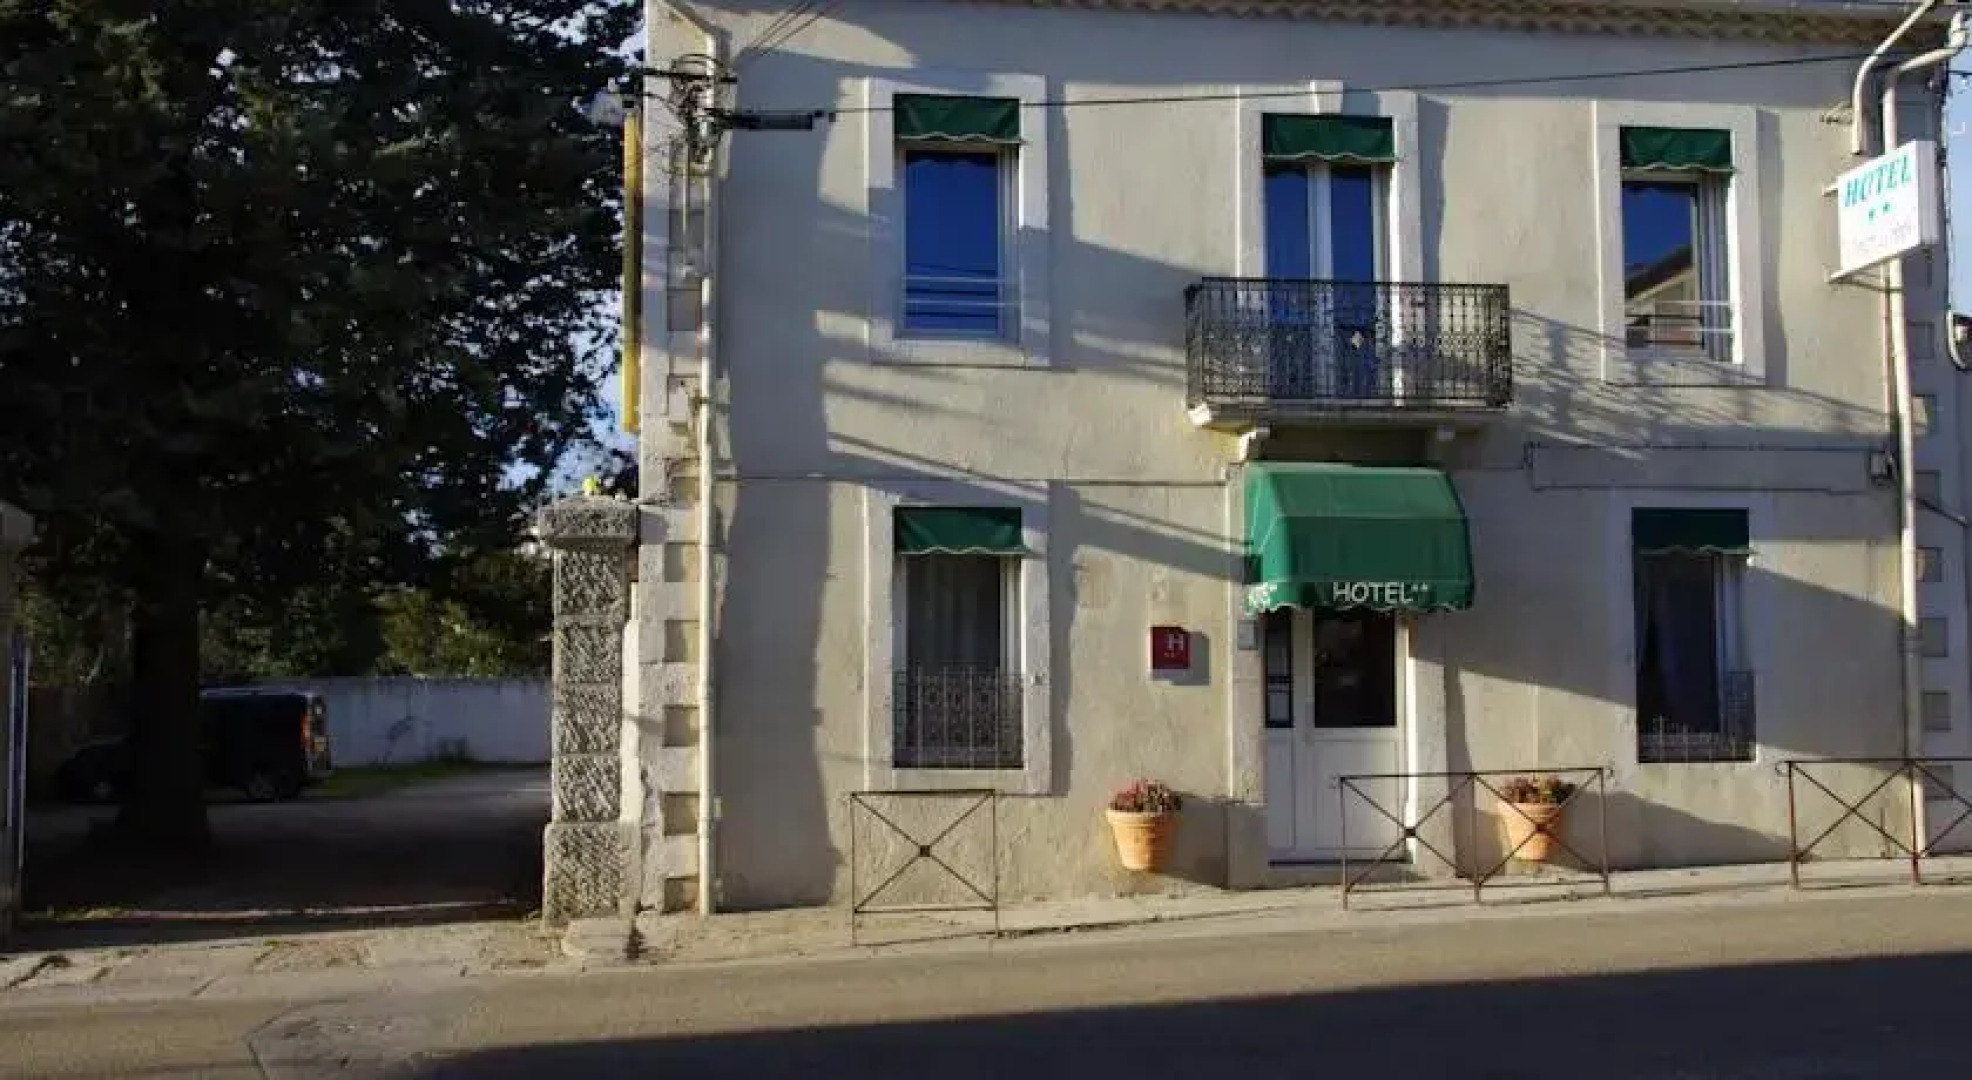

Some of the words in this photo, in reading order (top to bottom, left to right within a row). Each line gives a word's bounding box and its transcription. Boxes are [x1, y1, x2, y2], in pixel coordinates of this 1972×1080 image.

[1844, 153, 1911, 207] HOTEL
[1332, 580, 1413, 603] HOTEL
[1167, 633, 1184, 651] H
